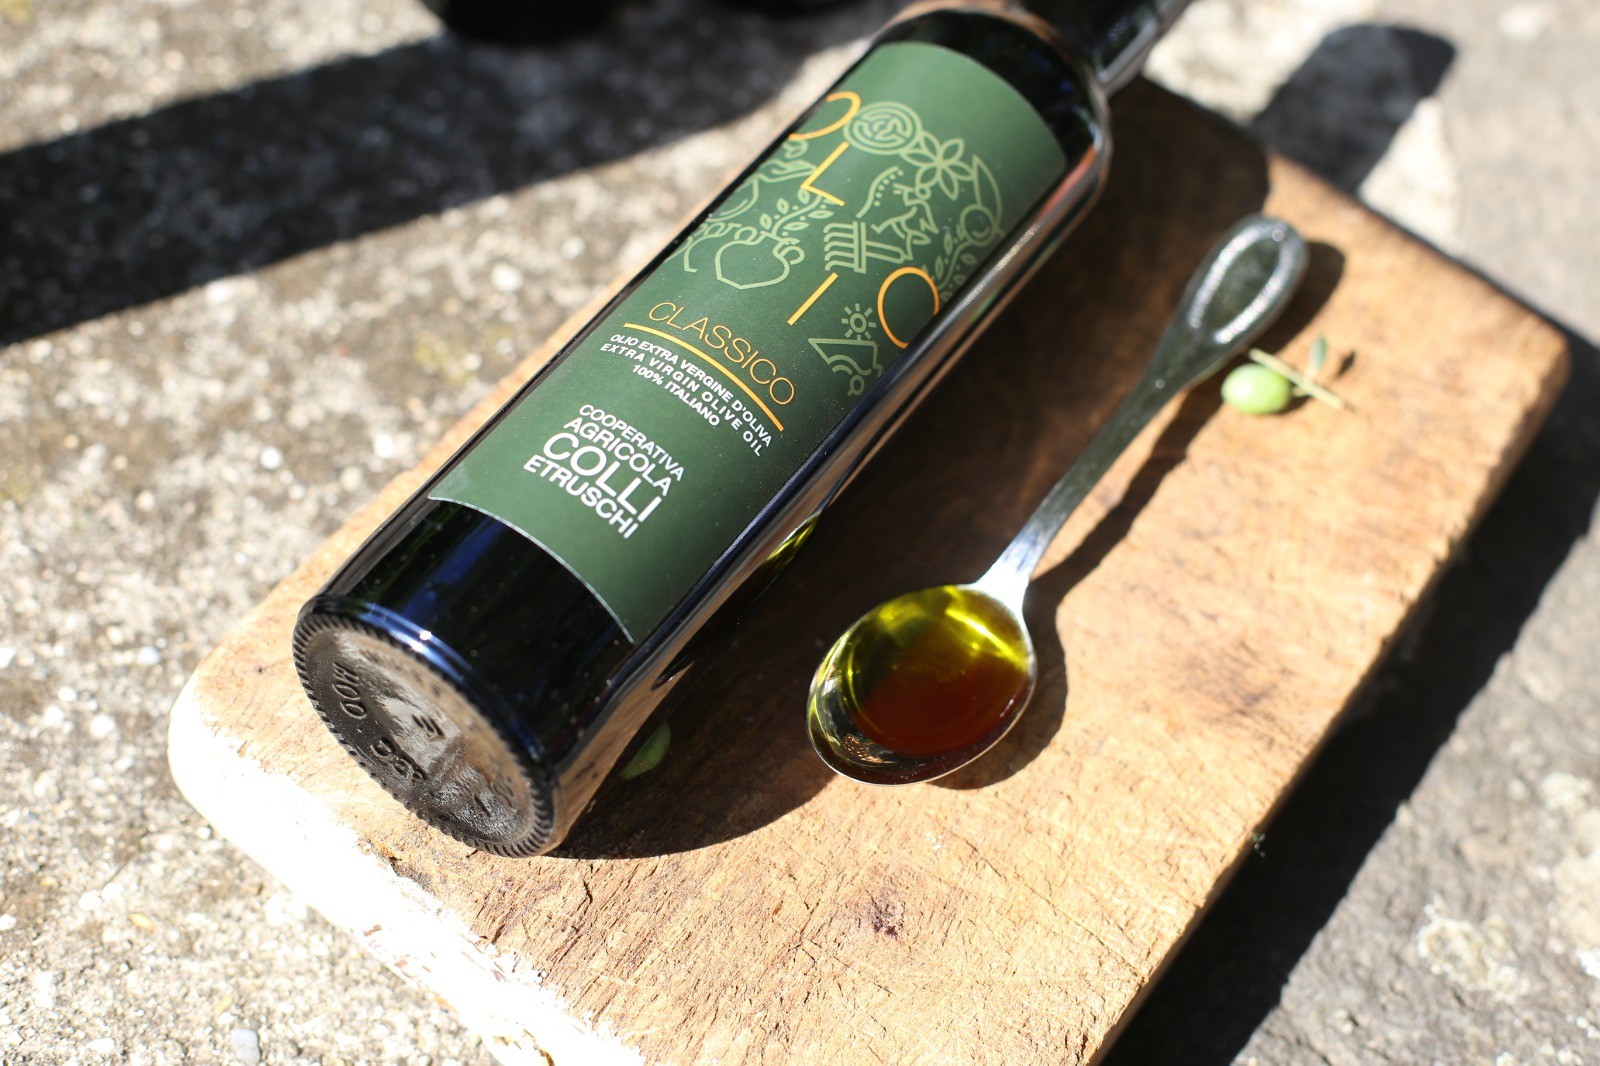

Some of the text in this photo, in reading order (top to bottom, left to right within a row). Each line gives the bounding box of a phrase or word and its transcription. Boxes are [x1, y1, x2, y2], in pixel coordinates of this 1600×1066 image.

[610, 334, 773, 447] OLIO EXTRA VERGINE D'OLIVA
[632, 364, 720, 426] 100% ITALIANO
[648, 302, 795, 405] CLASSICO
[579, 404, 685, 482] COOPERATIVA
[600, 343, 762, 457] EXTRA VIRGIN OLIVE OIL
[523, 455, 639, 539] ETRUSCHI
[543, 432, 662, 522] COLLI
[563, 417, 672, 497] AGRICOLA
